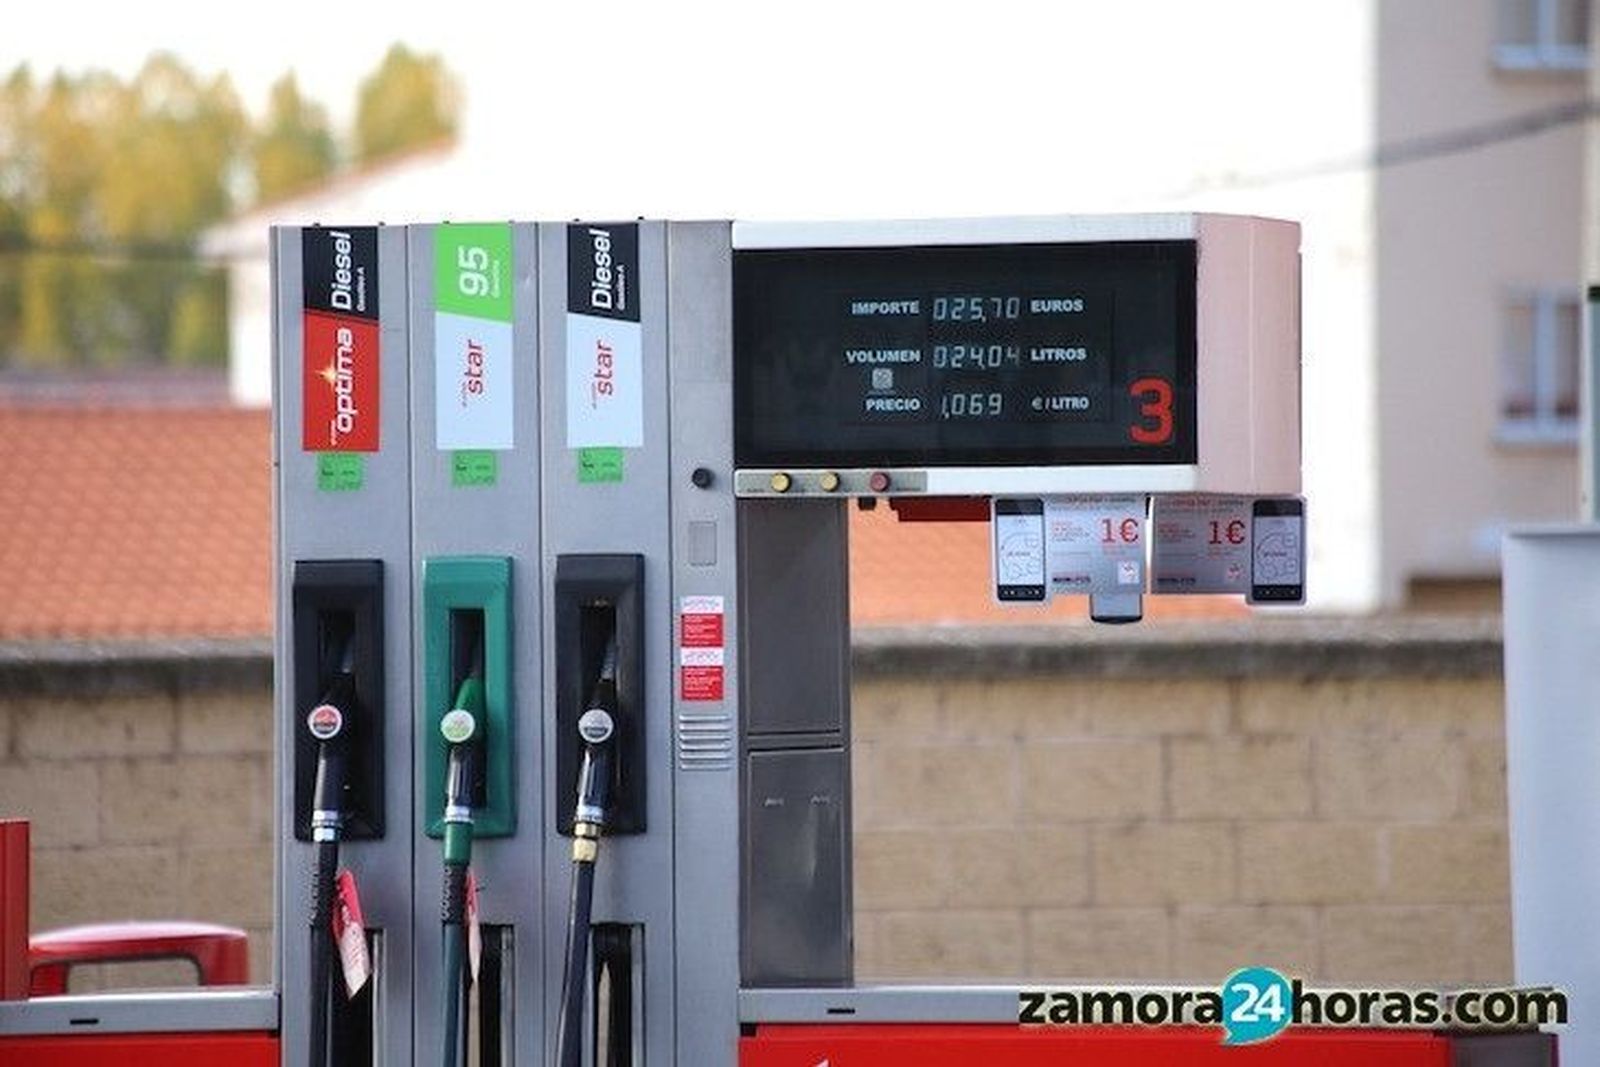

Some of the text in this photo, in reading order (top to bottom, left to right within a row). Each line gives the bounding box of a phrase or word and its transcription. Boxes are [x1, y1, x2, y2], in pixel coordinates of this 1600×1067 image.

[331, 230, 352, 311] Diesel
[458, 245, 488, 298] 95
[591, 228, 612, 310] Diesel
[851, 301, 920, 315] IMPORTE
[1031, 299, 1084, 313] EUROS
[334, 327, 358, 434] optima
[464, 339, 484, 396] star
[596, 338, 615, 396] star
[846, 349, 921, 363] VOLUMEN
[1031, 347, 1087, 361] LITROS
[866, 398, 921, 412] PRECIO
[1129, 376, 1176, 445] 3
[1101, 517, 1140, 544] 1€
[1207, 519, 1246, 545] 1€
